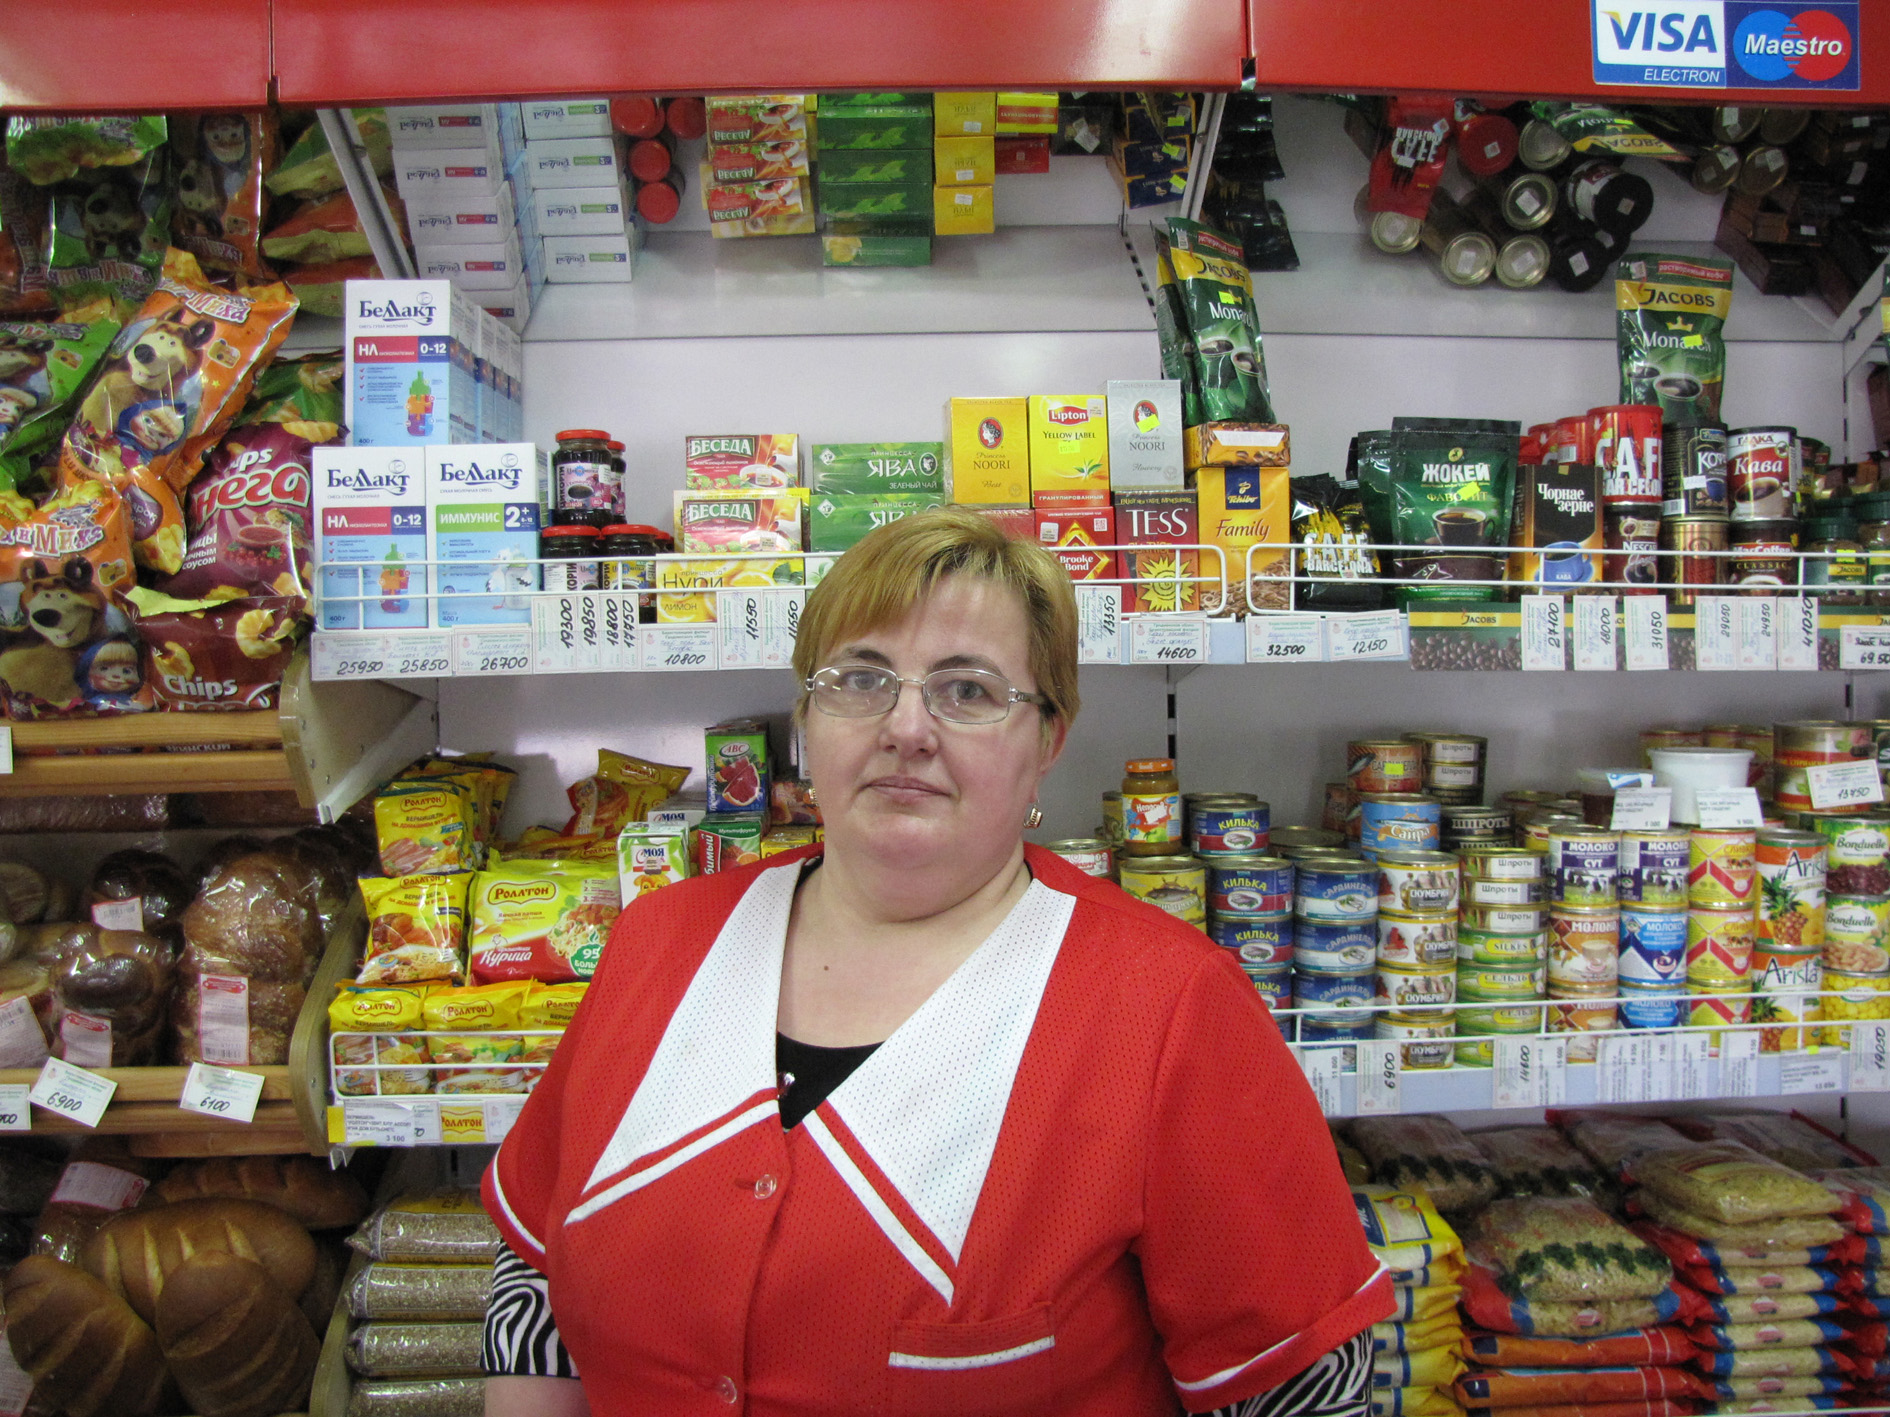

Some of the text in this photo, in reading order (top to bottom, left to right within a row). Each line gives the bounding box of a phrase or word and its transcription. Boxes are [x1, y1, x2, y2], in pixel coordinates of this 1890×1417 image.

[1600, 11, 1718, 54] VISA
[1744, 33, 1843, 56] Maestro
[1644, 69, 1720, 83] ELECTRON
[1638, 288, 1716, 308] JACOBS
[420, 343, 447, 355] 0-12
[1051, 410, 1087, 422] Lipton
[1043, 430, 1096, 440] YELLOW LABEL
[690, 438, 752, 459] БЕСЕДА
[1129, 441, 1165, 451] NOORI
[973, 460, 1011, 470] NOORI
[1595, 436, 1663, 481] CAF
[1734, 457, 1784, 476] Кава
[867, 458, 918, 478] ЯВА
[1421, 462, 1491, 483] ЖОКЕЙ
[889, 481, 938, 490] ЗЕЛЕНЫЙ ЧАЙ
[1537, 483, 1585, 505] Чорнае
[687, 503, 753, 522] БЕСЕДА
[1558, 500, 1594, 517] зерне
[393, 514, 422, 526] 0-12
[440, 512, 501, 525] ИММУНИС
[1125, 508, 1188, 537] TESS
[1215, 518, 1271, 541] Family
[1059, 555, 1094, 564] Brooke
[1065, 562, 1090, 571] Bond
[1305, 561, 1374, 574] BARCELONA
[1736, 561, 1787, 569] CLASSIC
[560, 598, 573, 649] 19300
[583, 596, 597, 647] 19850
[605, 598, 619, 647] 18800
[746, 597, 760, 640] 11550
[1461, 614, 1497, 625] JACOBS
[1548, 602, 1560, 648] 27100
[1600, 607, 1611, 646] 18000
[1720, 604, 1731, 638] 29050
[1760, 603, 1771, 637] 24950
[1802, 596, 1815, 648] 41050
[1651, 611, 1663, 650] 31050
[1156, 647, 1198, 660] 14600
[1266, 644, 1305, 656] 32500
[1352, 639, 1388, 653] 12150
[337, 660, 384, 676] 25950
[400, 658, 449, 674] 25850
[480, 656, 529, 671] 26700
[664, 653, 706, 667] 10800
[163, 674, 239, 701] Chips
[724, 743, 747, 754] ABC
[1218, 818, 1260, 830] КИЛЬКА
[1452, 816, 1511, 829] ШПРОТЫ
[1390, 823, 1431, 844] Сайра
[1569, 842, 1616, 852] МОЛОКО
[1648, 841, 1689, 851] МОЛОКО
[1836, 834, 1887, 852] Bonduelle
[1498, 859, 1533, 868] Шпроты
[1223, 878, 1267, 891] КИЛЬКА
[1482, 884, 1519, 893] Шпроты
[494, 887, 550, 901] Роллтон
[1498, 912, 1533, 921] Шпроты
[1827, 912, 1876, 930] Bonduelle
[1647, 922, 1683, 932] МОЛОКО
[1235, 929, 1279, 943] КИЛЬКА
[479, 950, 533, 967] Курица
[447, 1005, 488, 1017] Роллтон
[1874, 1026, 1886, 1071] 19050
[1384, 1052, 1395, 1090] 6900
[46, 1091, 82, 1112] 6900
[200, 1096, 231, 1112] 6100
